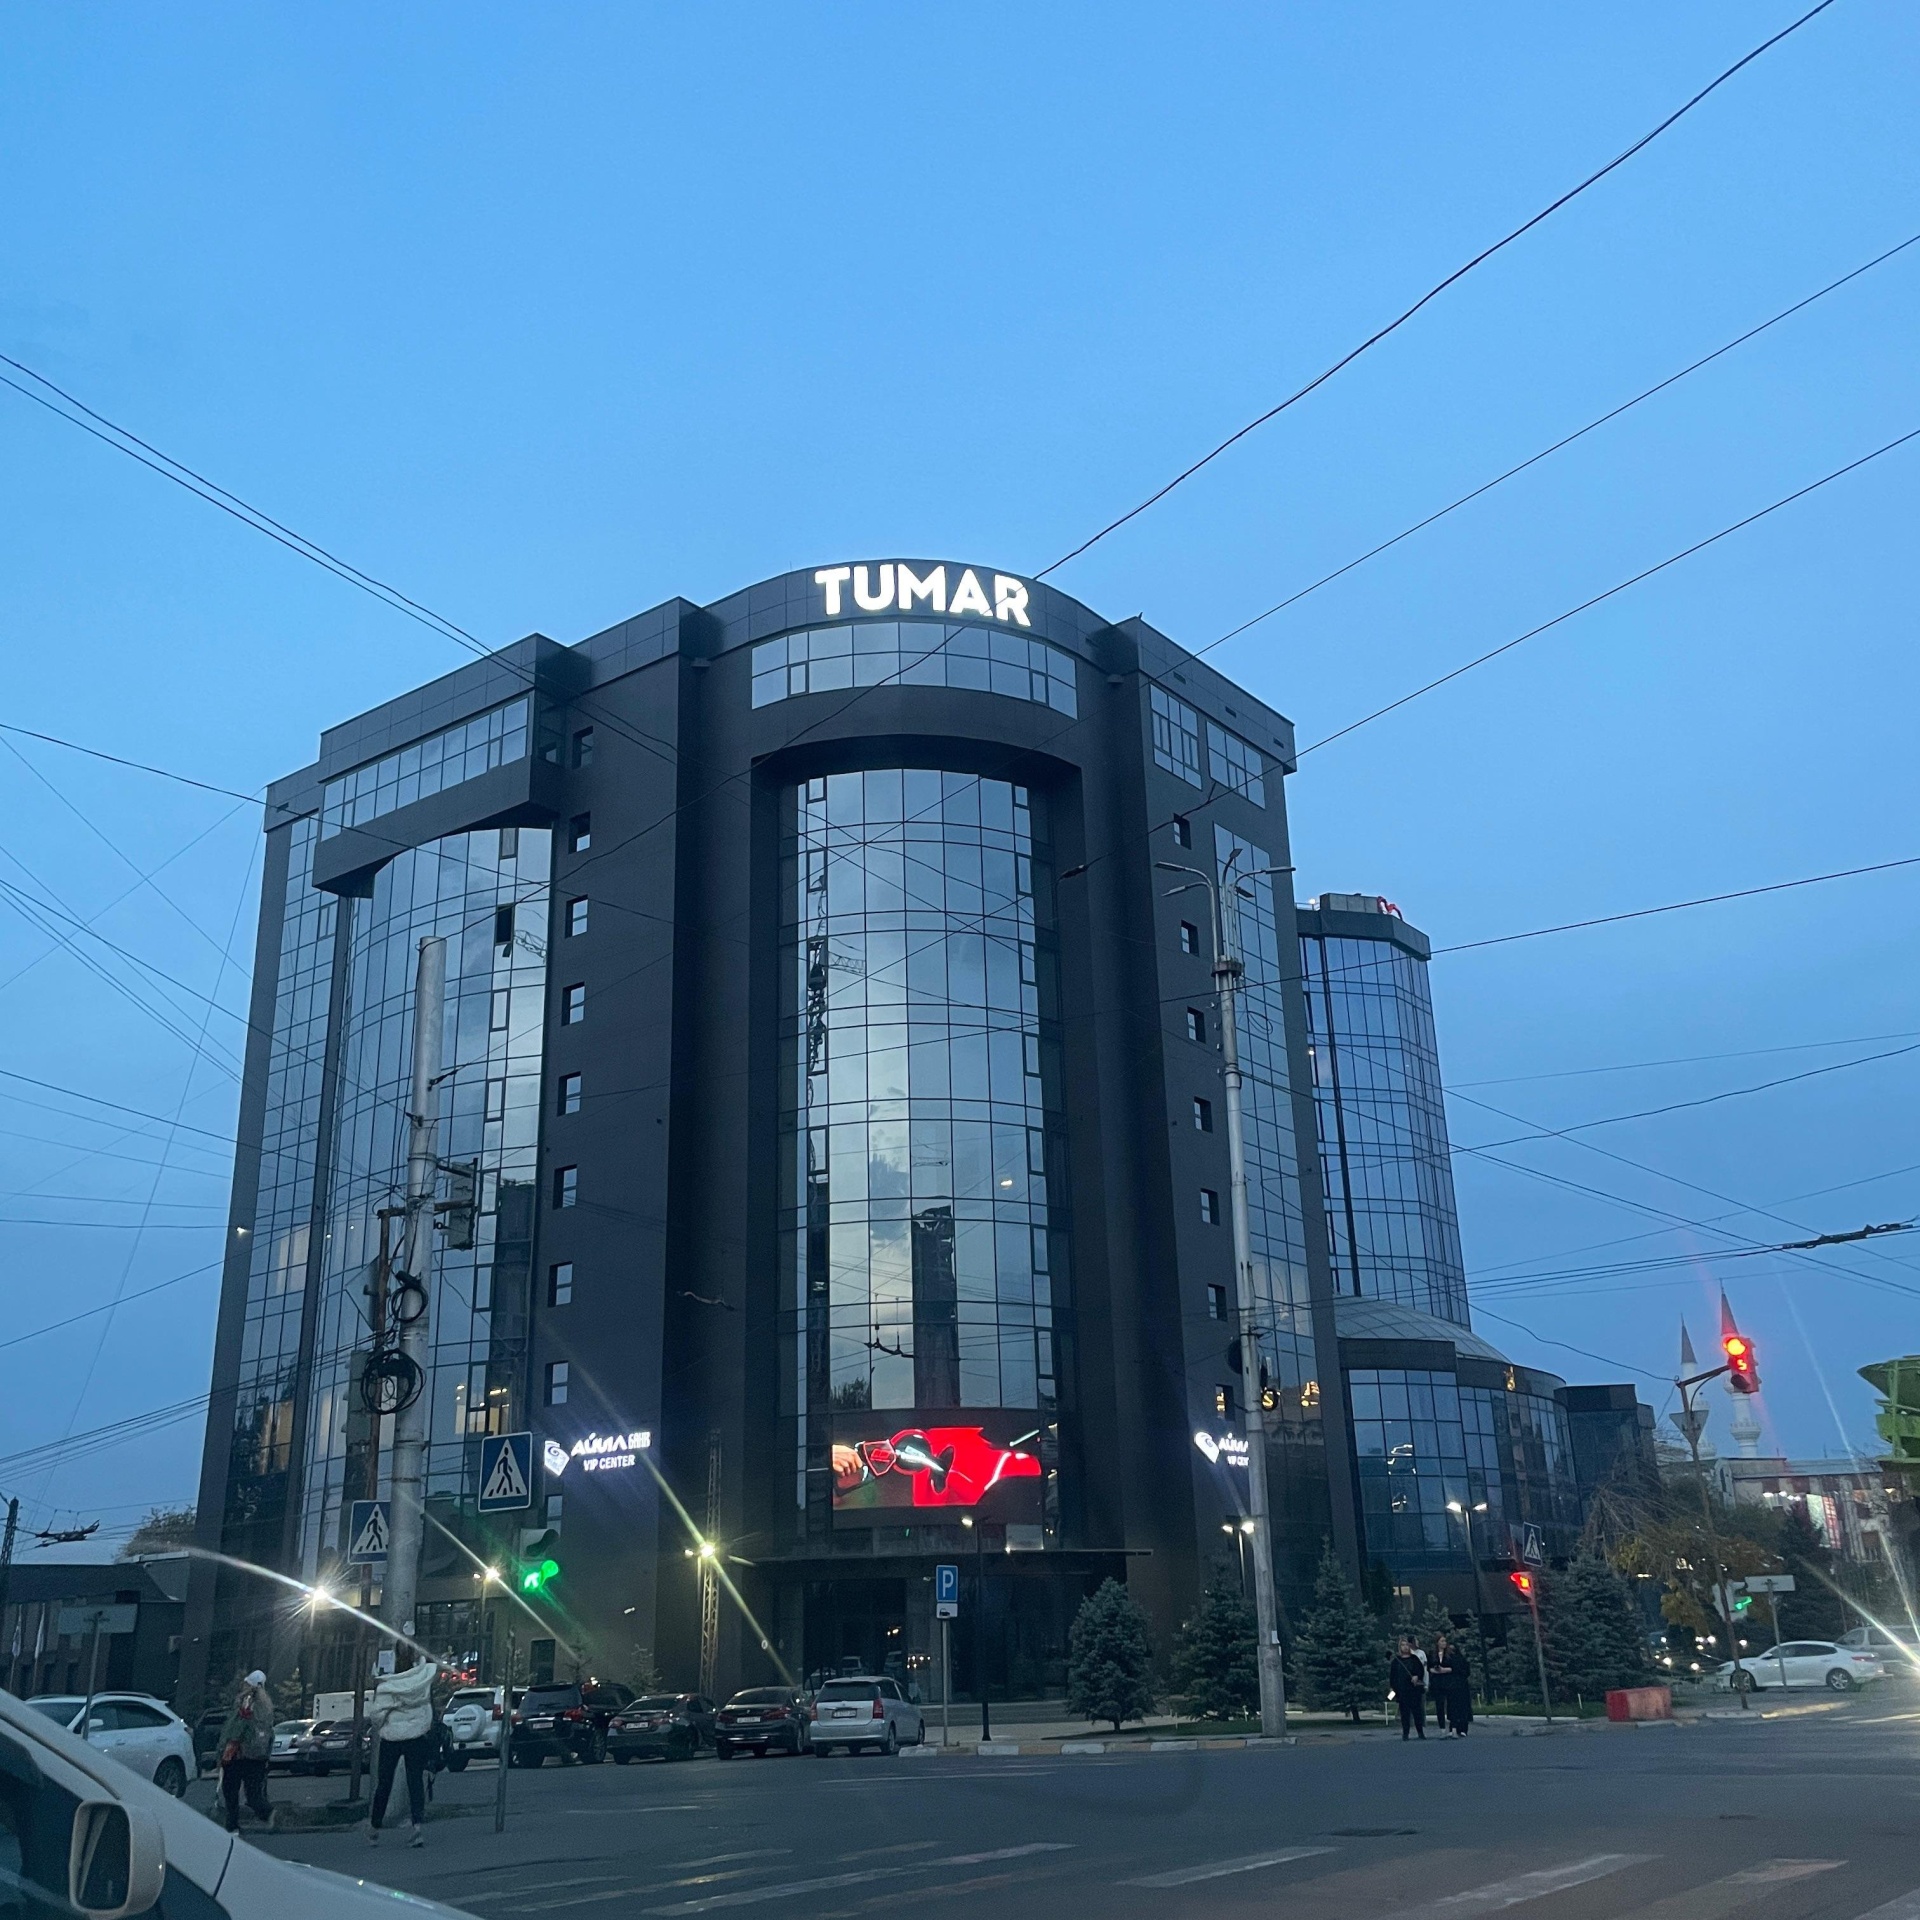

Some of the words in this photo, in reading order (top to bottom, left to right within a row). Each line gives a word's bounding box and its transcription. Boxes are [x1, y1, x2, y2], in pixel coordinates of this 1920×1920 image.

[814, 563, 1031, 627] TUMAR
[583, 1458, 599, 1471] VIP
[599, 1454, 636, 1470] CENTER
[943, 1570, 954, 1597] P
